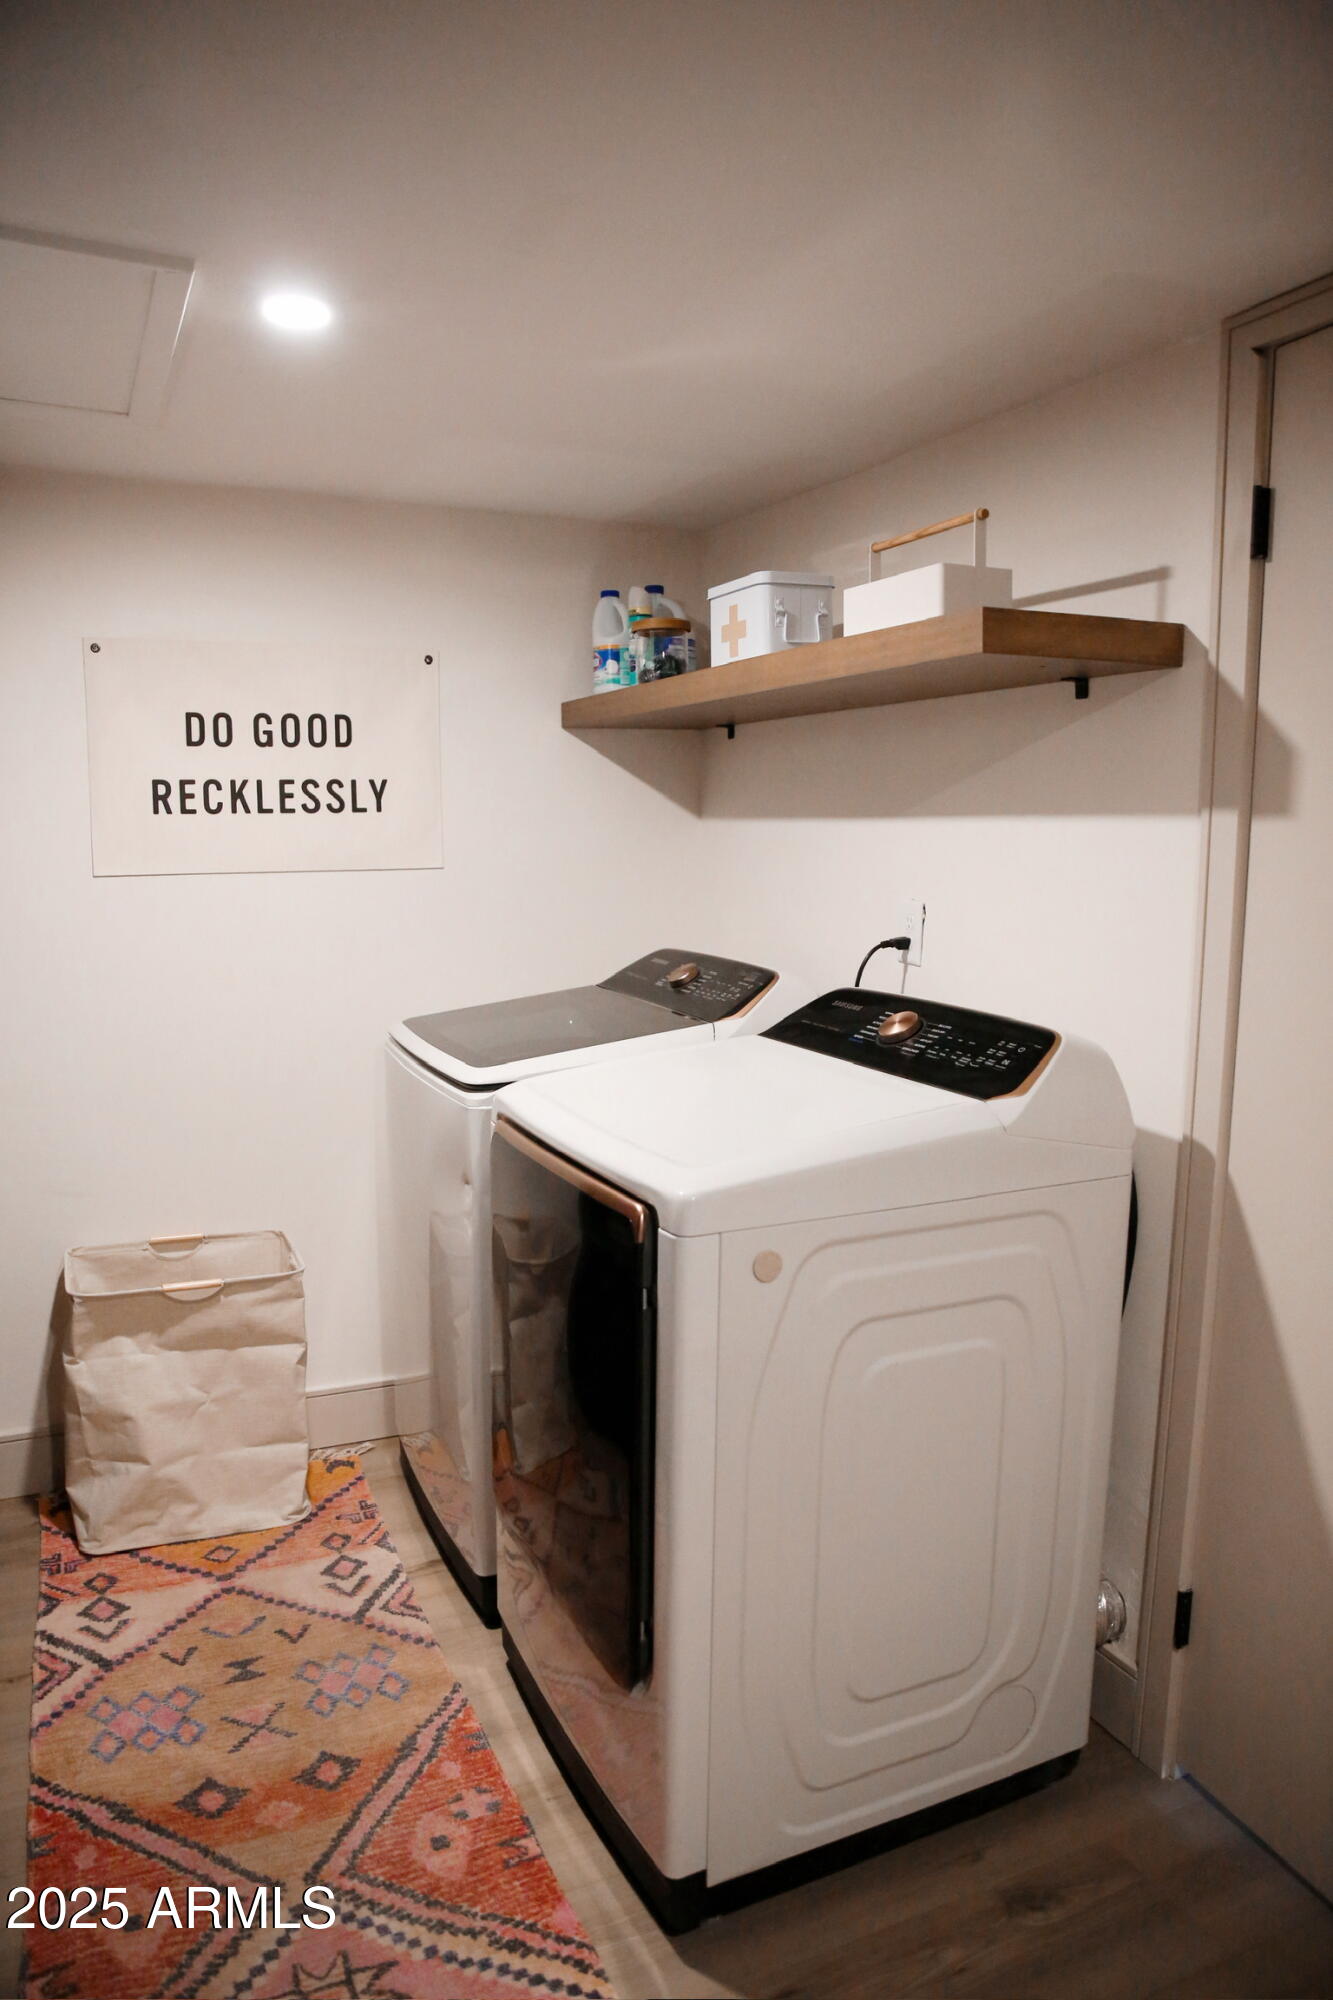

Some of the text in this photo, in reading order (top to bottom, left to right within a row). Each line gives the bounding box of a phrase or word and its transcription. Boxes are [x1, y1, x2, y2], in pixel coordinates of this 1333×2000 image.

[186, 711, 353, 748] DO GOOD
[152, 778, 388, 815] RECKLESSLY
